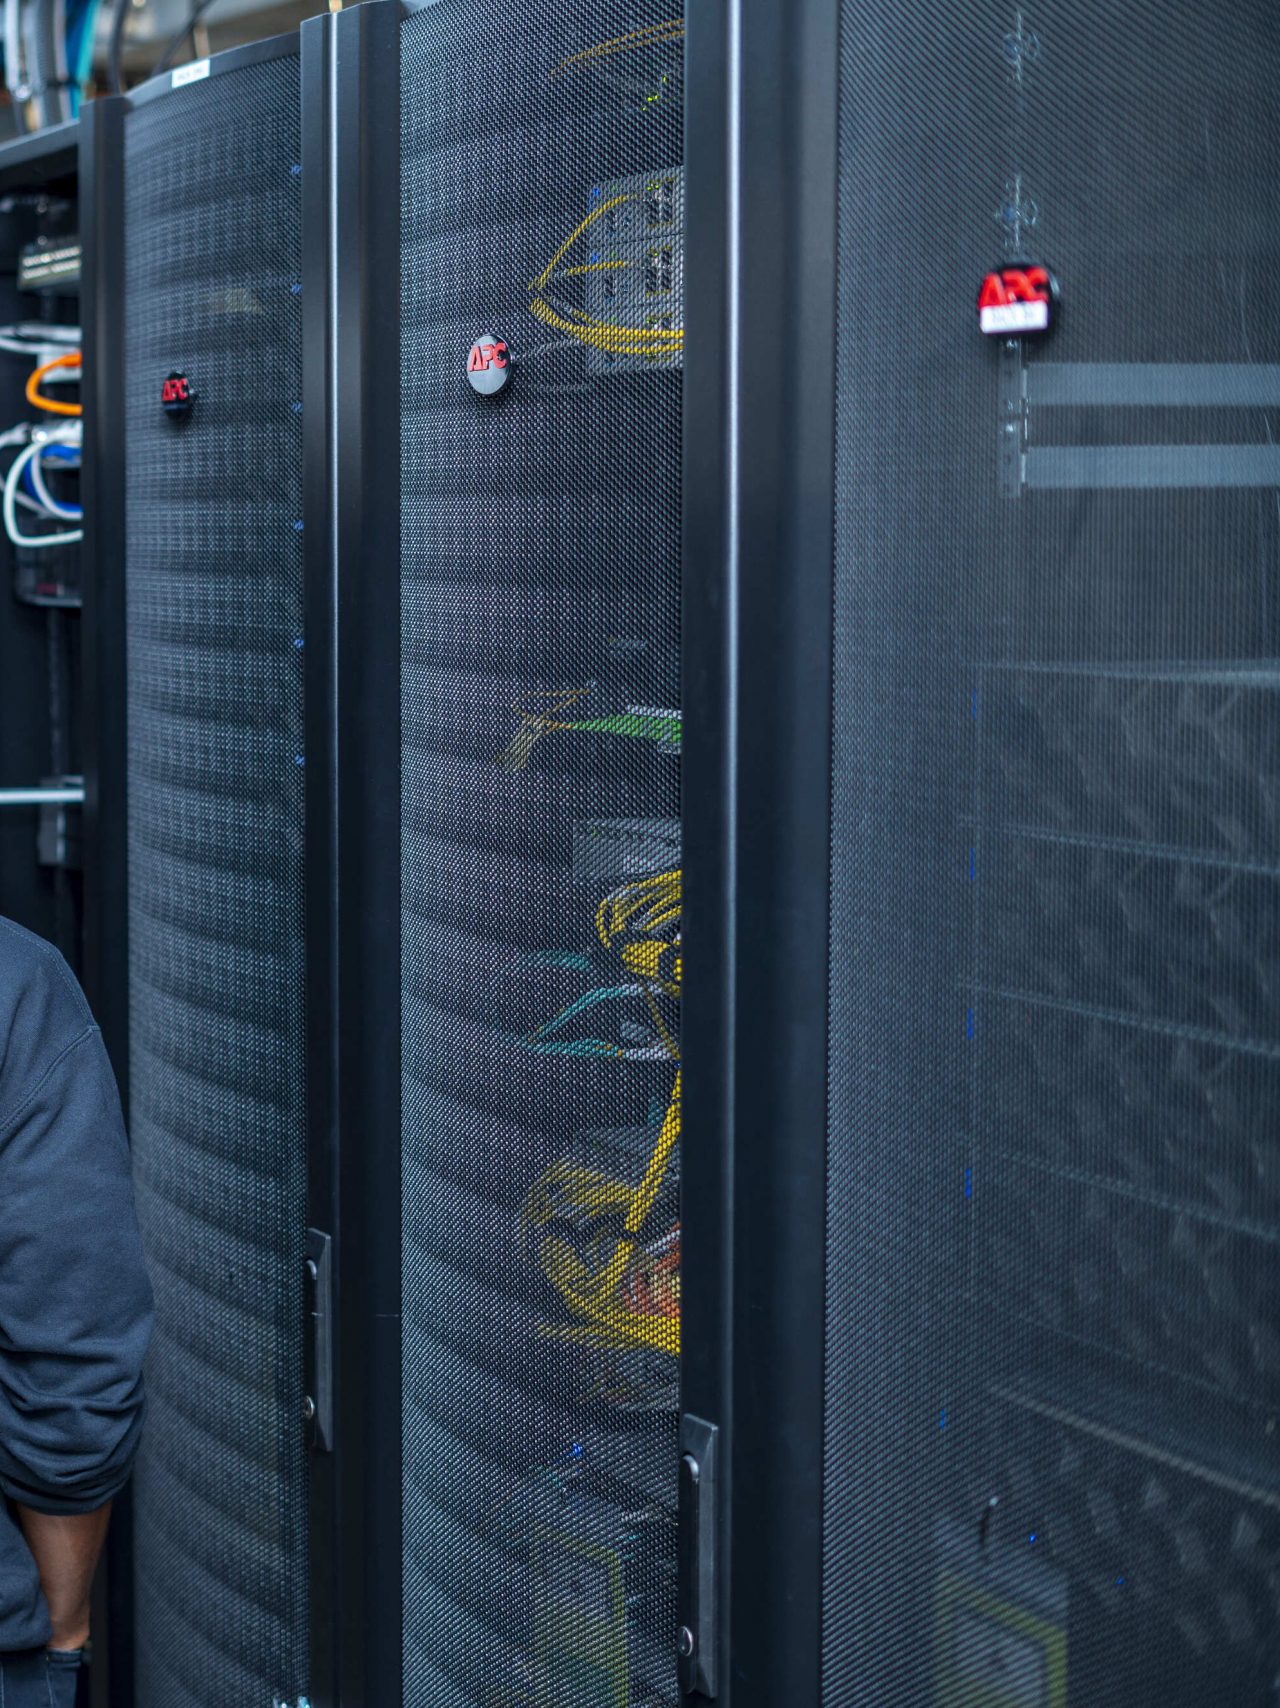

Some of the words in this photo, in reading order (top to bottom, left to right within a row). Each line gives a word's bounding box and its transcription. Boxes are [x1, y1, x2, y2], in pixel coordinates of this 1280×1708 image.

[977, 265, 1049, 309] APC
[468, 341, 507, 372] APC
[161, 377, 188, 402] APC
